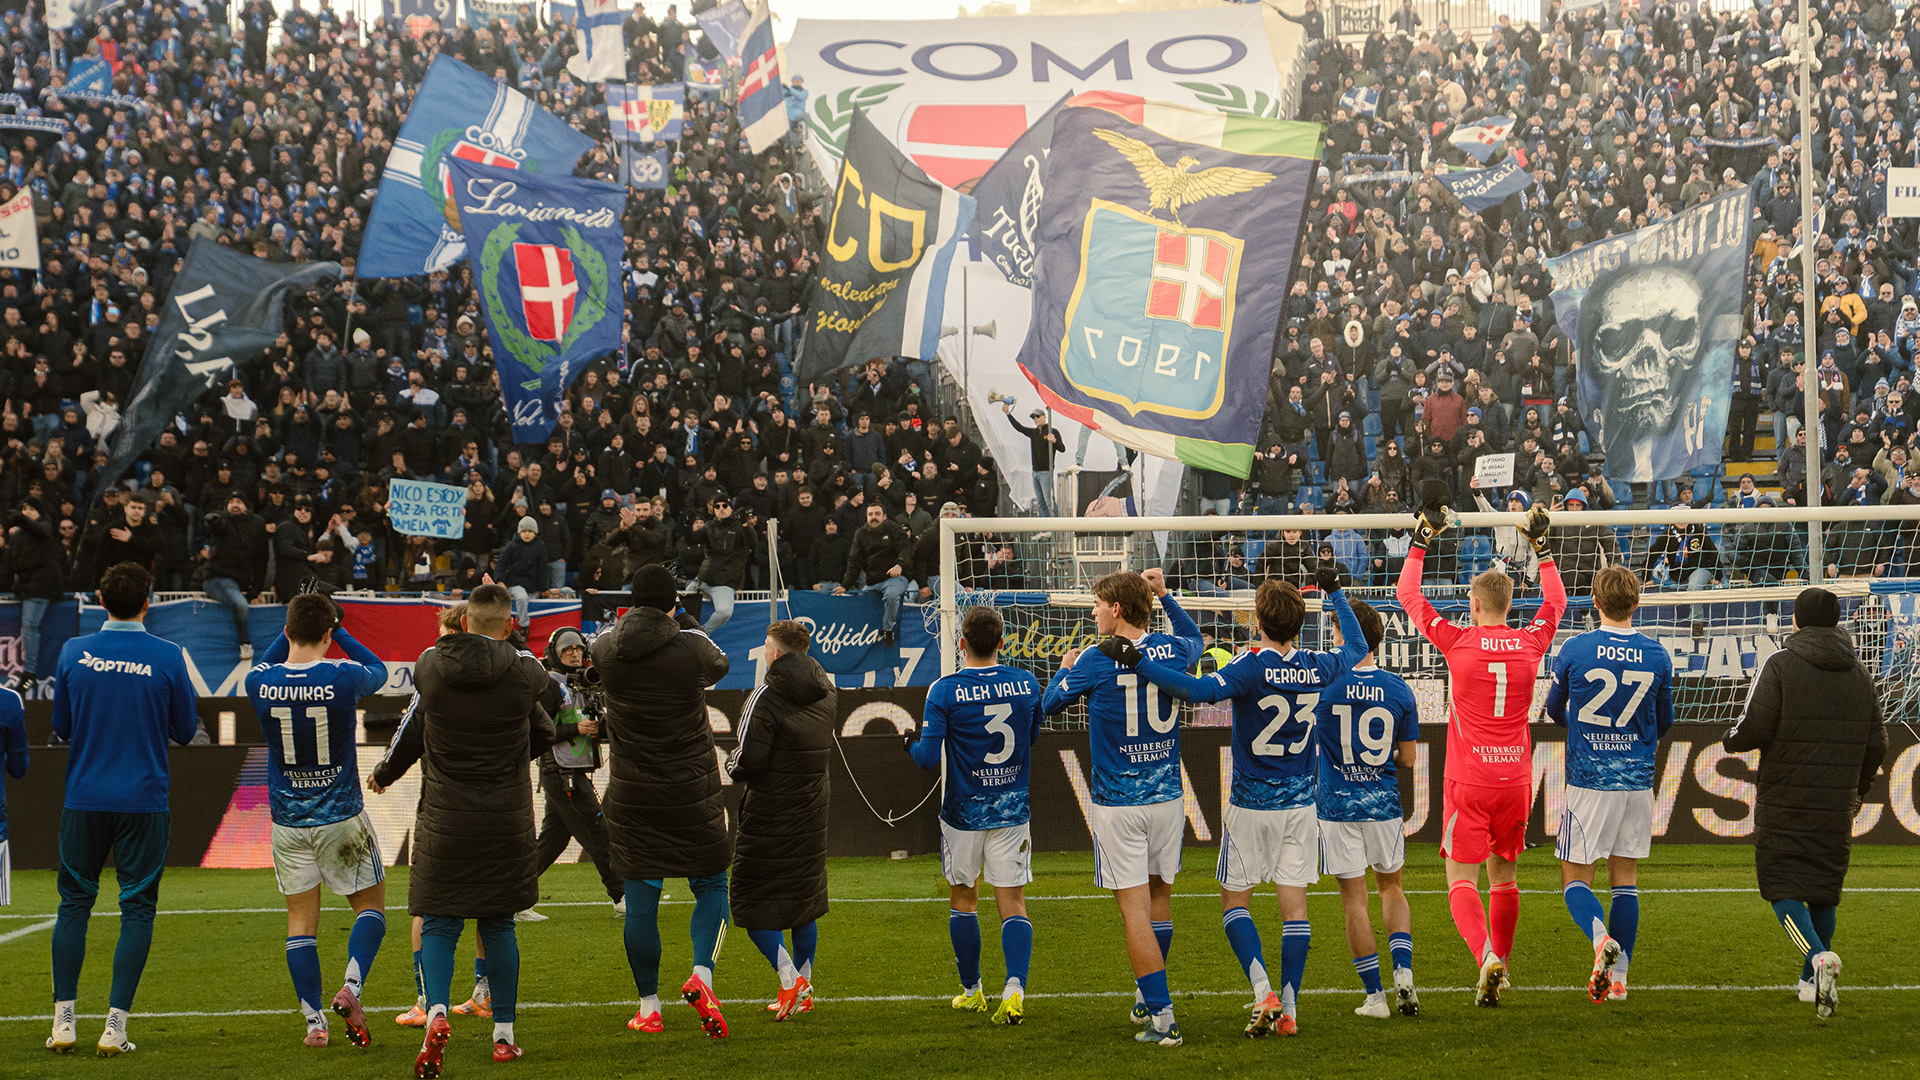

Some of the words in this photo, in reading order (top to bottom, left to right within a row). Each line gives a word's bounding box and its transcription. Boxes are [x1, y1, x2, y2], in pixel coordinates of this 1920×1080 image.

[818, 35, 1248, 82] COMO
[465, 125, 527, 160] COMO
[392, 483, 423, 502] NICO
[793, 616, 888, 654] Diffida
[1481, 637, 1523, 652] BUTEZ
[1146, 643, 1176, 662] PAZ
[1597, 645, 1643, 663] POSCH
[93, 660, 152, 677] OPTIMA
[1265, 667, 1321, 685] PERRONE
[259, 683, 335, 700] DOUVIKAS
[955, 684, 991, 702] ÁLEX
[994, 680, 1032, 698] VALLE
[1346, 681, 1385, 702] KÜHN
[1487, 662, 1508, 718] 1
[1577, 667, 1655, 728] 27
[1116, 673, 1180, 737] 10
[983, 702, 1016, 765] 3
[1251, 692, 1321, 756] 23
[270, 706, 331, 766] 11
[1332, 704, 1395, 766] 19
[1582, 733, 1640, 742] NEUBERGER
[1472, 745, 1525, 755] NEUBERGER
[1592, 743, 1632, 751] BERMAN
[1130, 750, 1170, 764] BERMAN
[1482, 755, 1521, 764] BERMAN
[982, 774, 1017, 787] BERMAN
